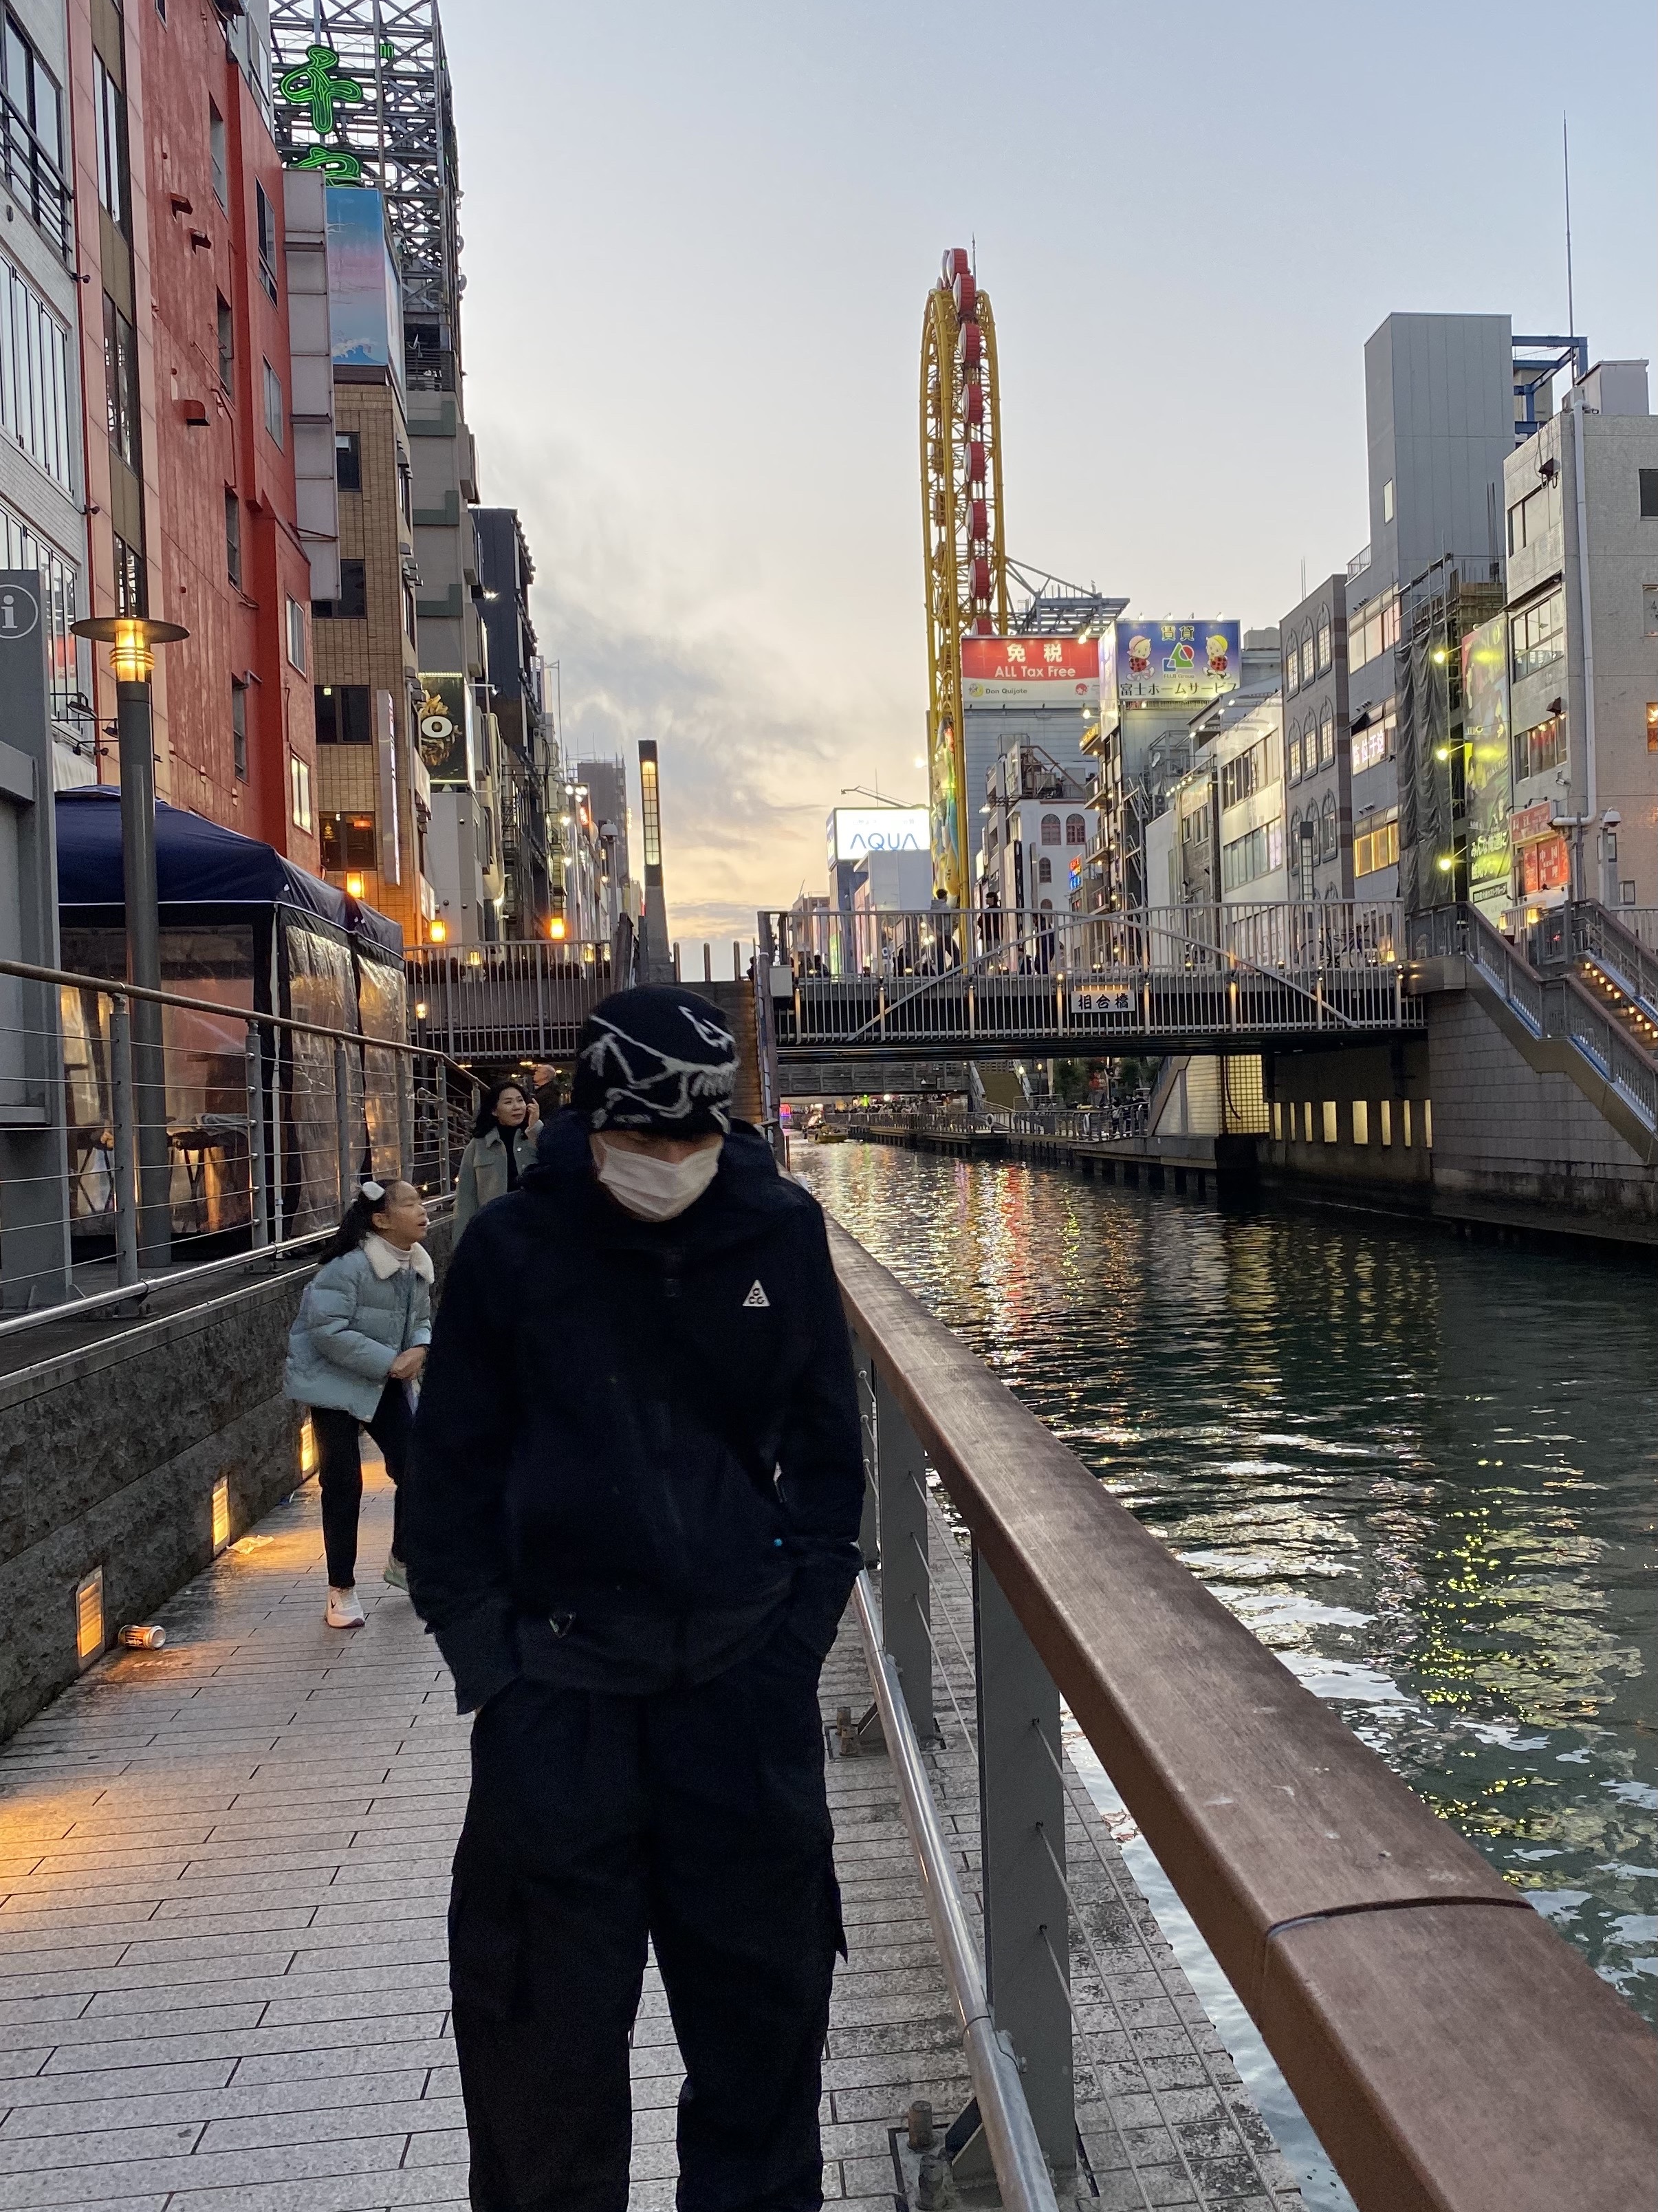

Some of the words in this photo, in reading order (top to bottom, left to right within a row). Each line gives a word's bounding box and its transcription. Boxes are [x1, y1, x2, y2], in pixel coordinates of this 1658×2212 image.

[1161, 625, 1195, 641] 賃貸
[1007, 643, 1062, 662] 免税
[994, 666, 1017, 677] ALL
[1021, 666, 1044, 677] Tax
[1048, 666, 1076, 677] Free
[850, 832, 919, 850] AQUA
[1078, 993, 1129, 1010] 相合橋
